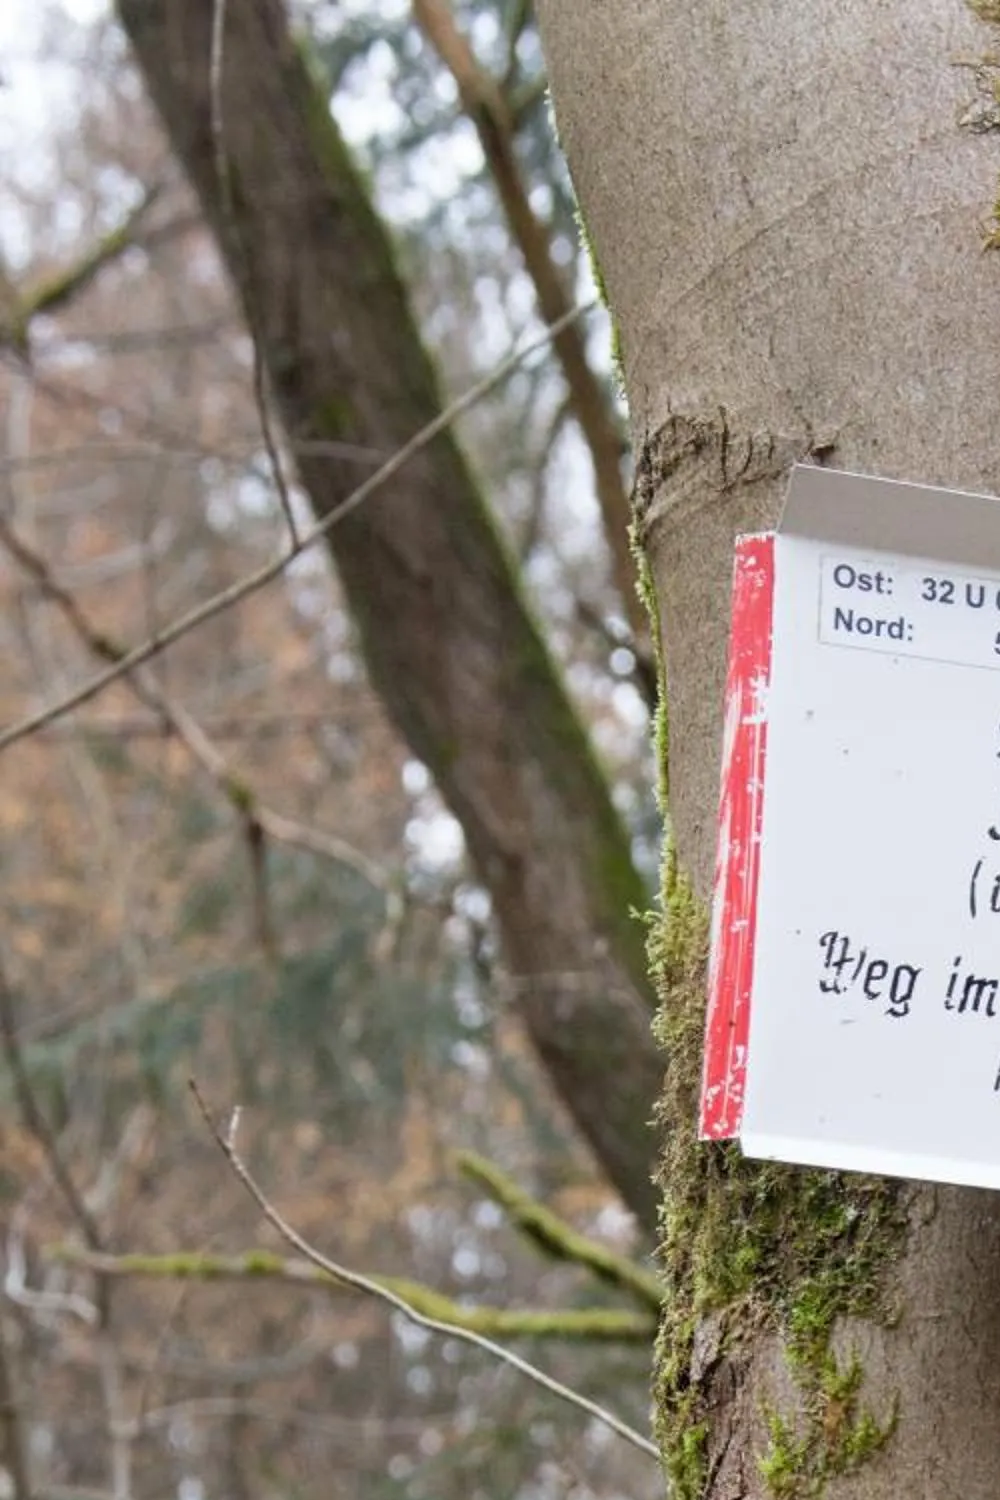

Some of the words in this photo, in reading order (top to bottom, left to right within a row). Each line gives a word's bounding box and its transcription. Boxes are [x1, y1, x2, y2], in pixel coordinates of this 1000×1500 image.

[833, 564, 893, 595] Ost:
[921, 578, 955, 605] 32
[965, 584, 985, 609] U
[833, 607, 913, 641] Nord:
[819, 931, 923, 1018] Weg
[944, 956, 999, 1017] im
